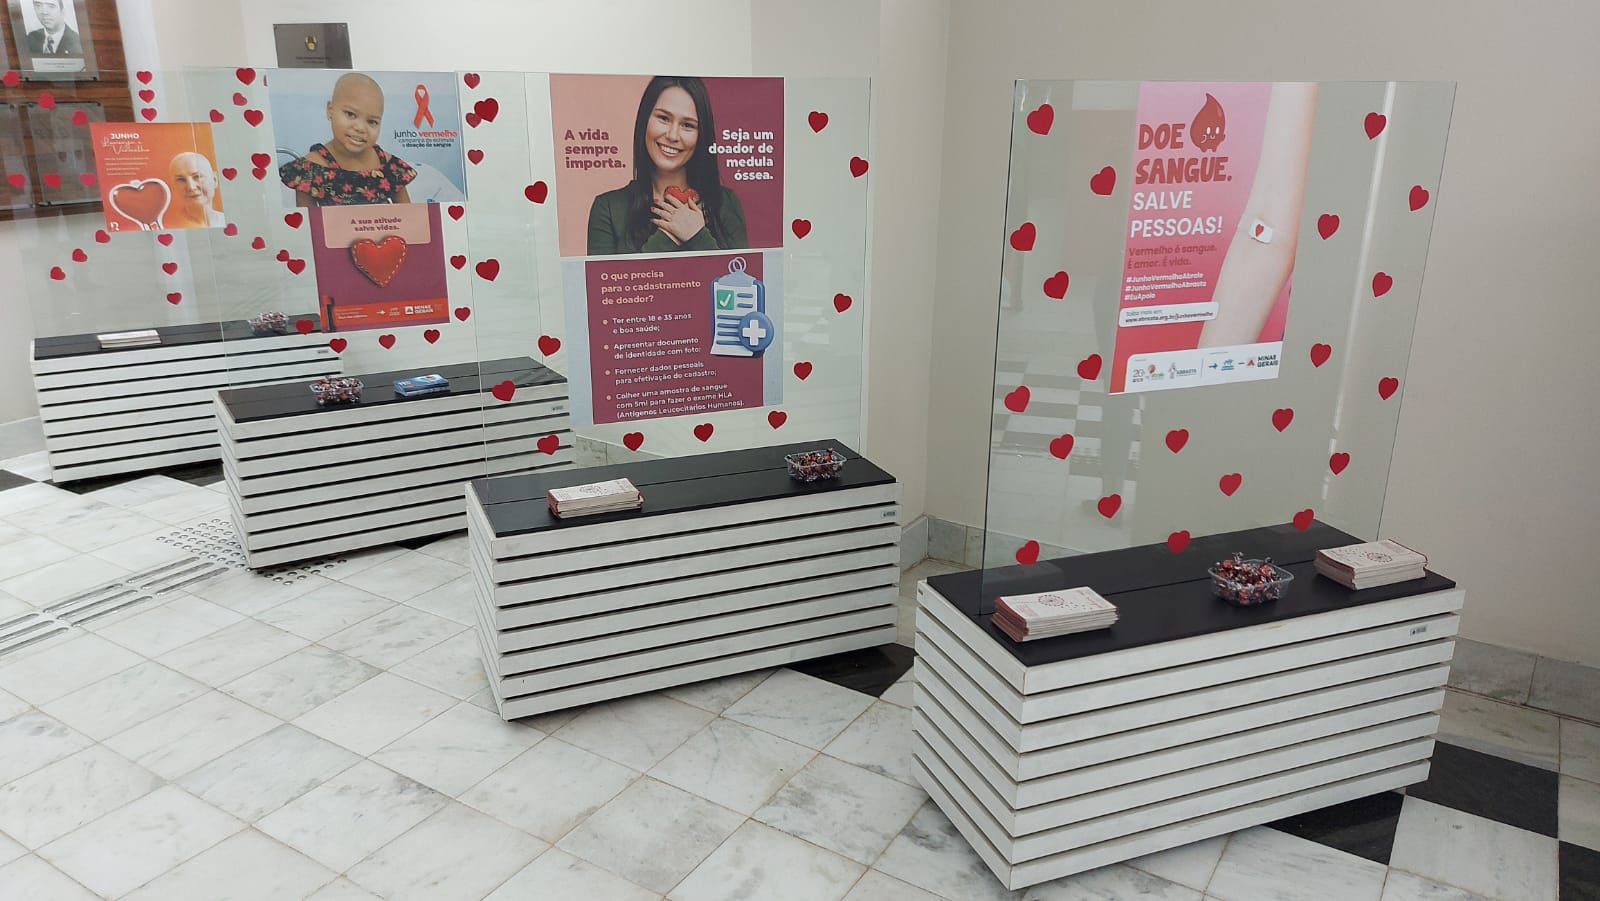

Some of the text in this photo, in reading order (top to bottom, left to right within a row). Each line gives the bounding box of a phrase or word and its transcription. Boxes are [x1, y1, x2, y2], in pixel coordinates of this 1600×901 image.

[394, 130, 417, 139] junho
[564, 129, 609, 141] A vida
[722, 130, 774, 143] Seja um
[1138, 123, 1185, 150] DOE
[565, 144, 618, 156] sempre
[708, 143, 774, 154] doador de
[565, 158, 626, 171] importa.
[726, 157, 774, 167] medula
[734, 169, 774, 181] óssea.
[1136, 156, 1232, 184] SANGUE.
[1133, 191, 1192, 211] SALVE
[1130, 216, 1223, 238] PESSOAS!
[1129, 244, 1217, 256] Vermelho é sangue.
[1128, 256, 1191, 269] É amor. É vida.
[611, 273, 629, 282] que
[631, 270, 664, 280] precisa
[601, 286, 622, 295] para
[632, 280, 701, 291] cadastramento
[616, 295, 654, 304] doador?
[636, 324, 660, 333] saúde;
[614, 337, 698, 351] Apresentar documento
[626, 349, 665, 359] identidade
[615, 361, 704, 375] Fornecer dados pessoais
[633, 374, 672, 384] efetivação
[685, 370, 717, 378] cadastro;
[616, 392, 640, 400] Colher
[660, 387, 690, 396] amostra
[702, 384, 728, 393] sangue
[650, 399, 666, 407] para
[616, 400, 745, 420] (Antígenos Leucocitários Humanos).
